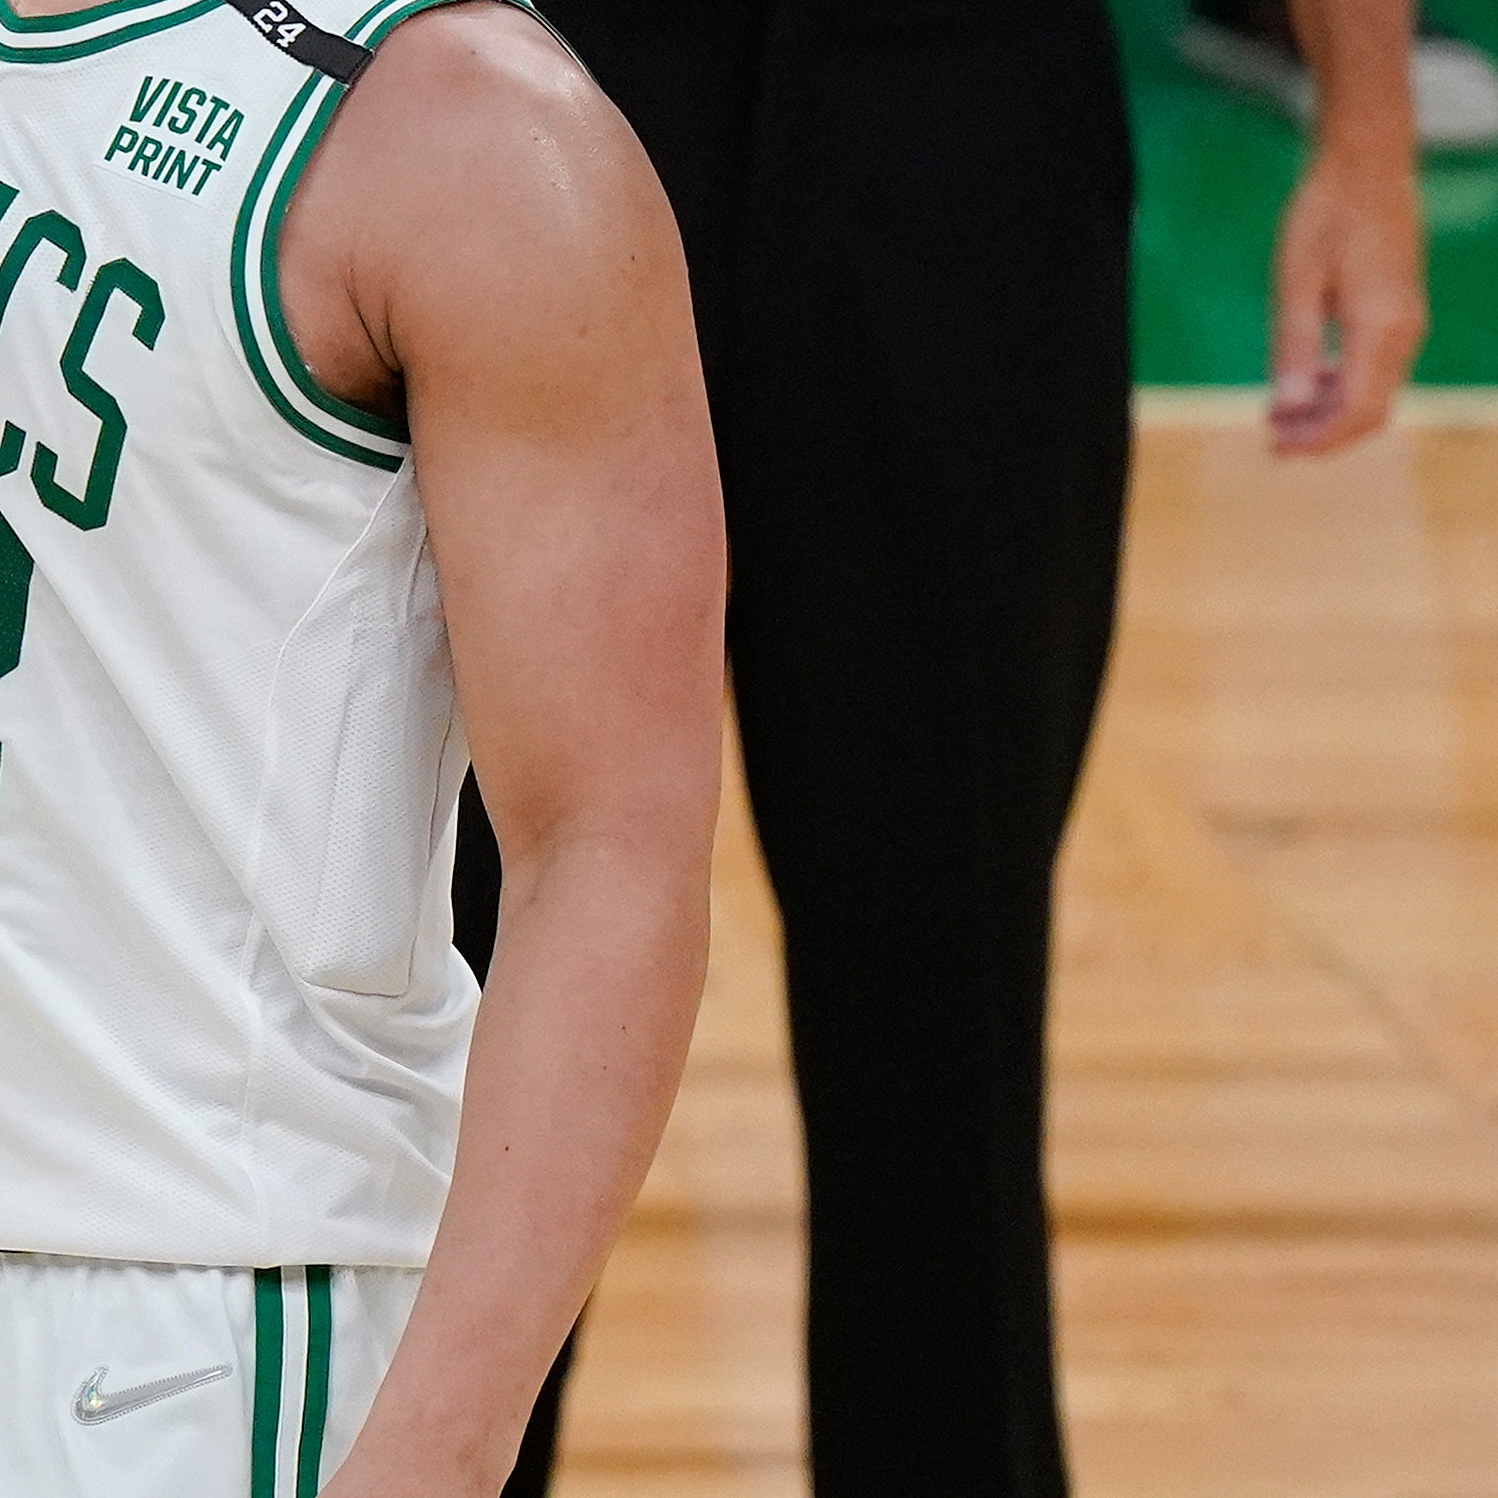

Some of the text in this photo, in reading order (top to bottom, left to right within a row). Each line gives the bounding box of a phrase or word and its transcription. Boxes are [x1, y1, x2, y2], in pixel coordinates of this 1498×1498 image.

[252, 0, 307, 49] 24
[129, 75, 245, 162] VISTA
[104, 125, 223, 197] PRINT
